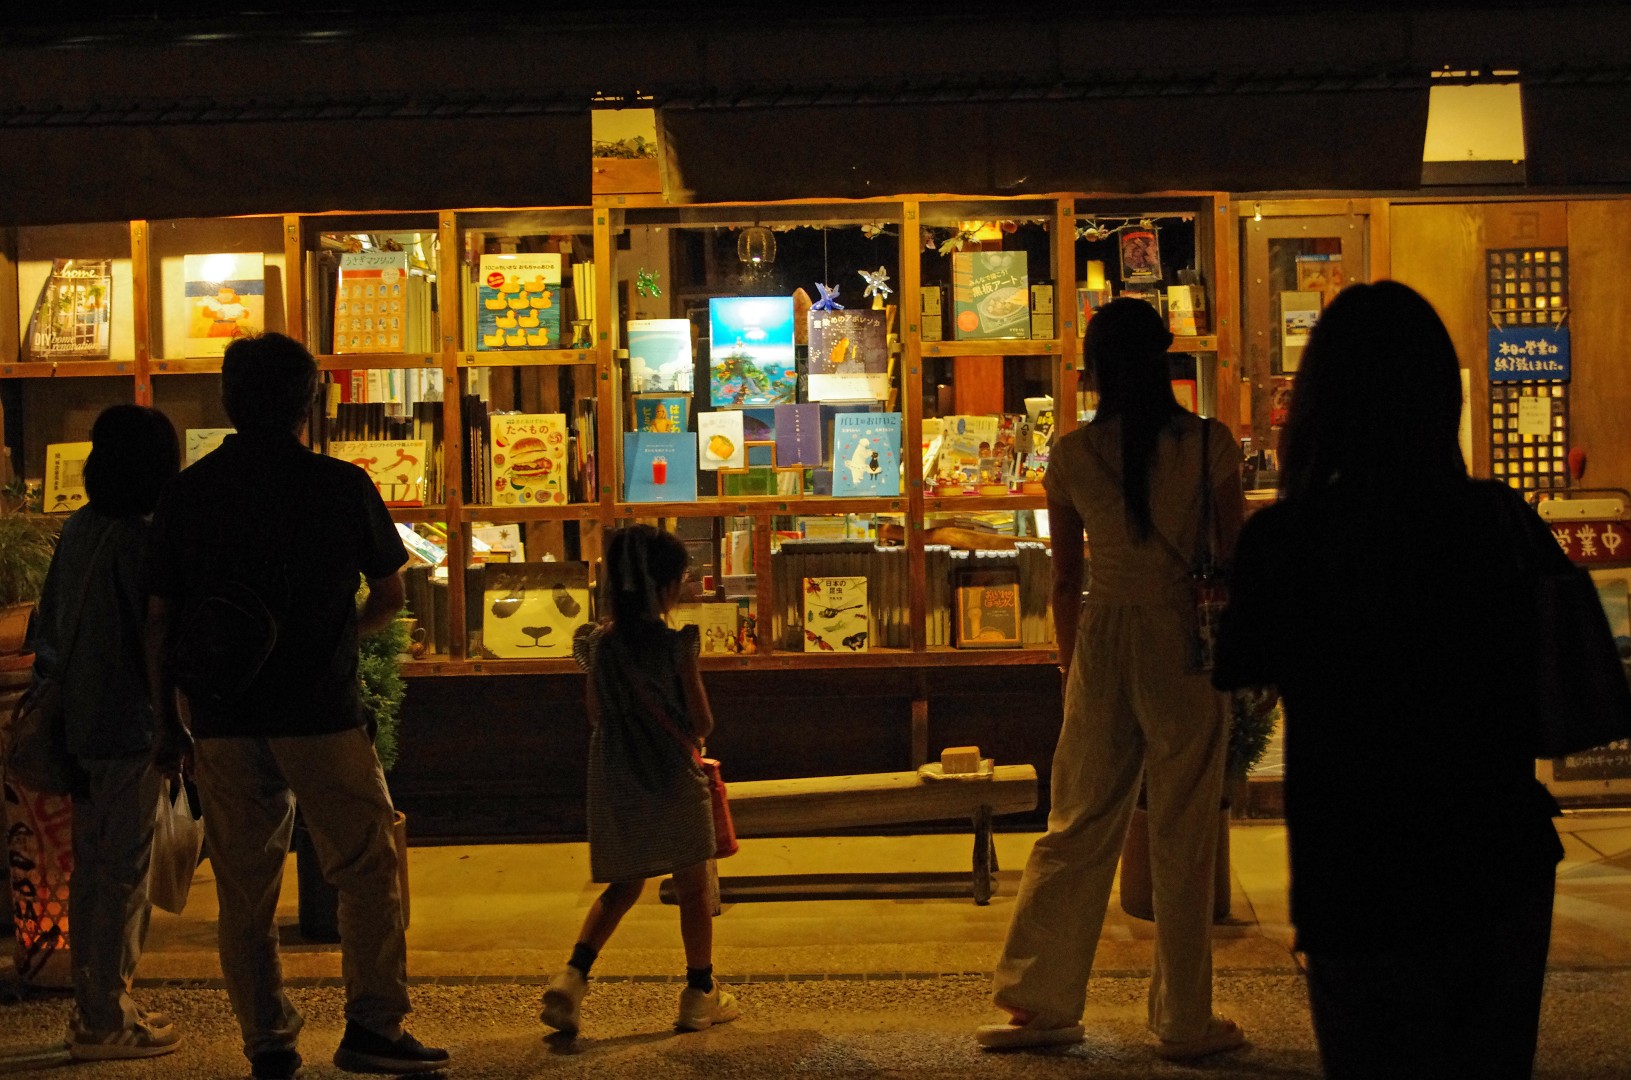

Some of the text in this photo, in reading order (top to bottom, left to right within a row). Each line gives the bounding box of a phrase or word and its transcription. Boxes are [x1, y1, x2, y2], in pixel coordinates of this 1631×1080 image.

[971, 274, 1018, 298] 黒板アート
[34, 332, 52, 346] DIY
[1498, 339, 1558, 356] 本日の営業は
[840, 415, 896, 426] バレエのおけいこ
[506, 424, 549, 435] たべもの
